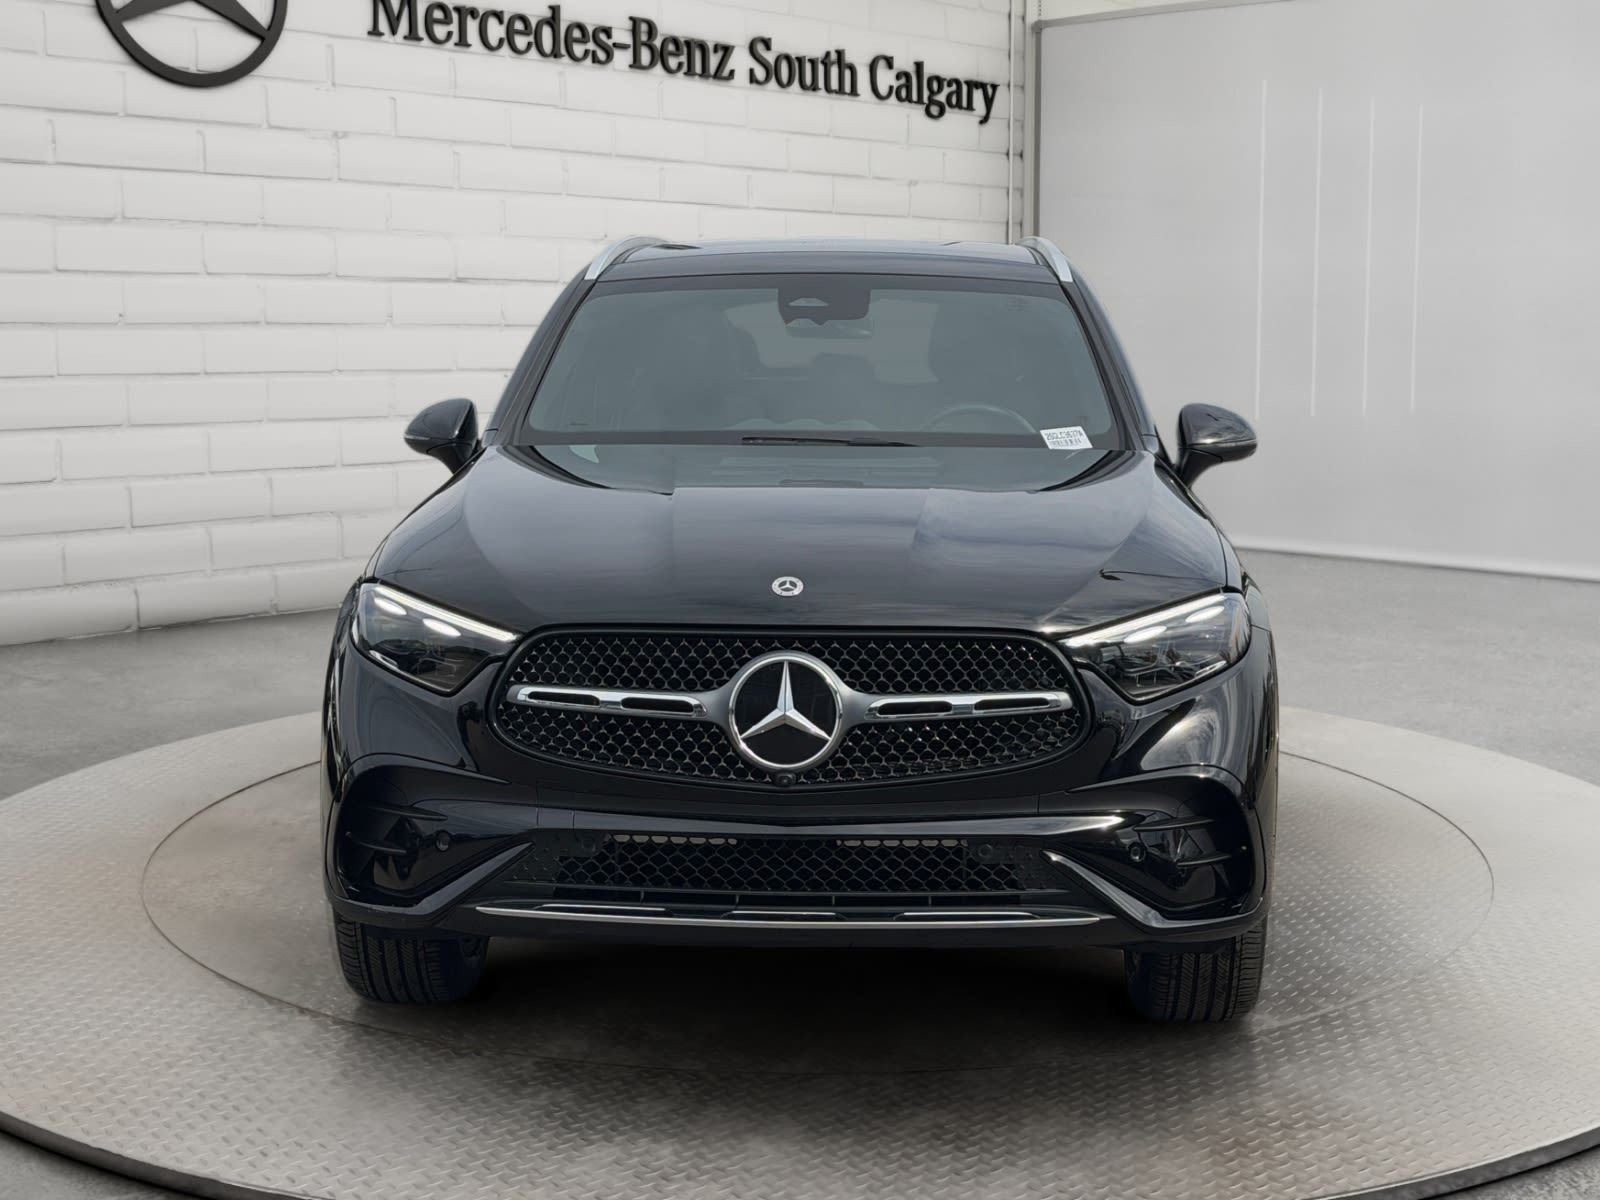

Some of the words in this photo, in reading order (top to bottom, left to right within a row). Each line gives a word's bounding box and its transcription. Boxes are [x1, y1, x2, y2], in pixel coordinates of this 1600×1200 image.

[367, 0, 735, 81] Mercedes-Benz
[748, 37, 859, 97] South
[869, 55, 1000, 125] Calgary
